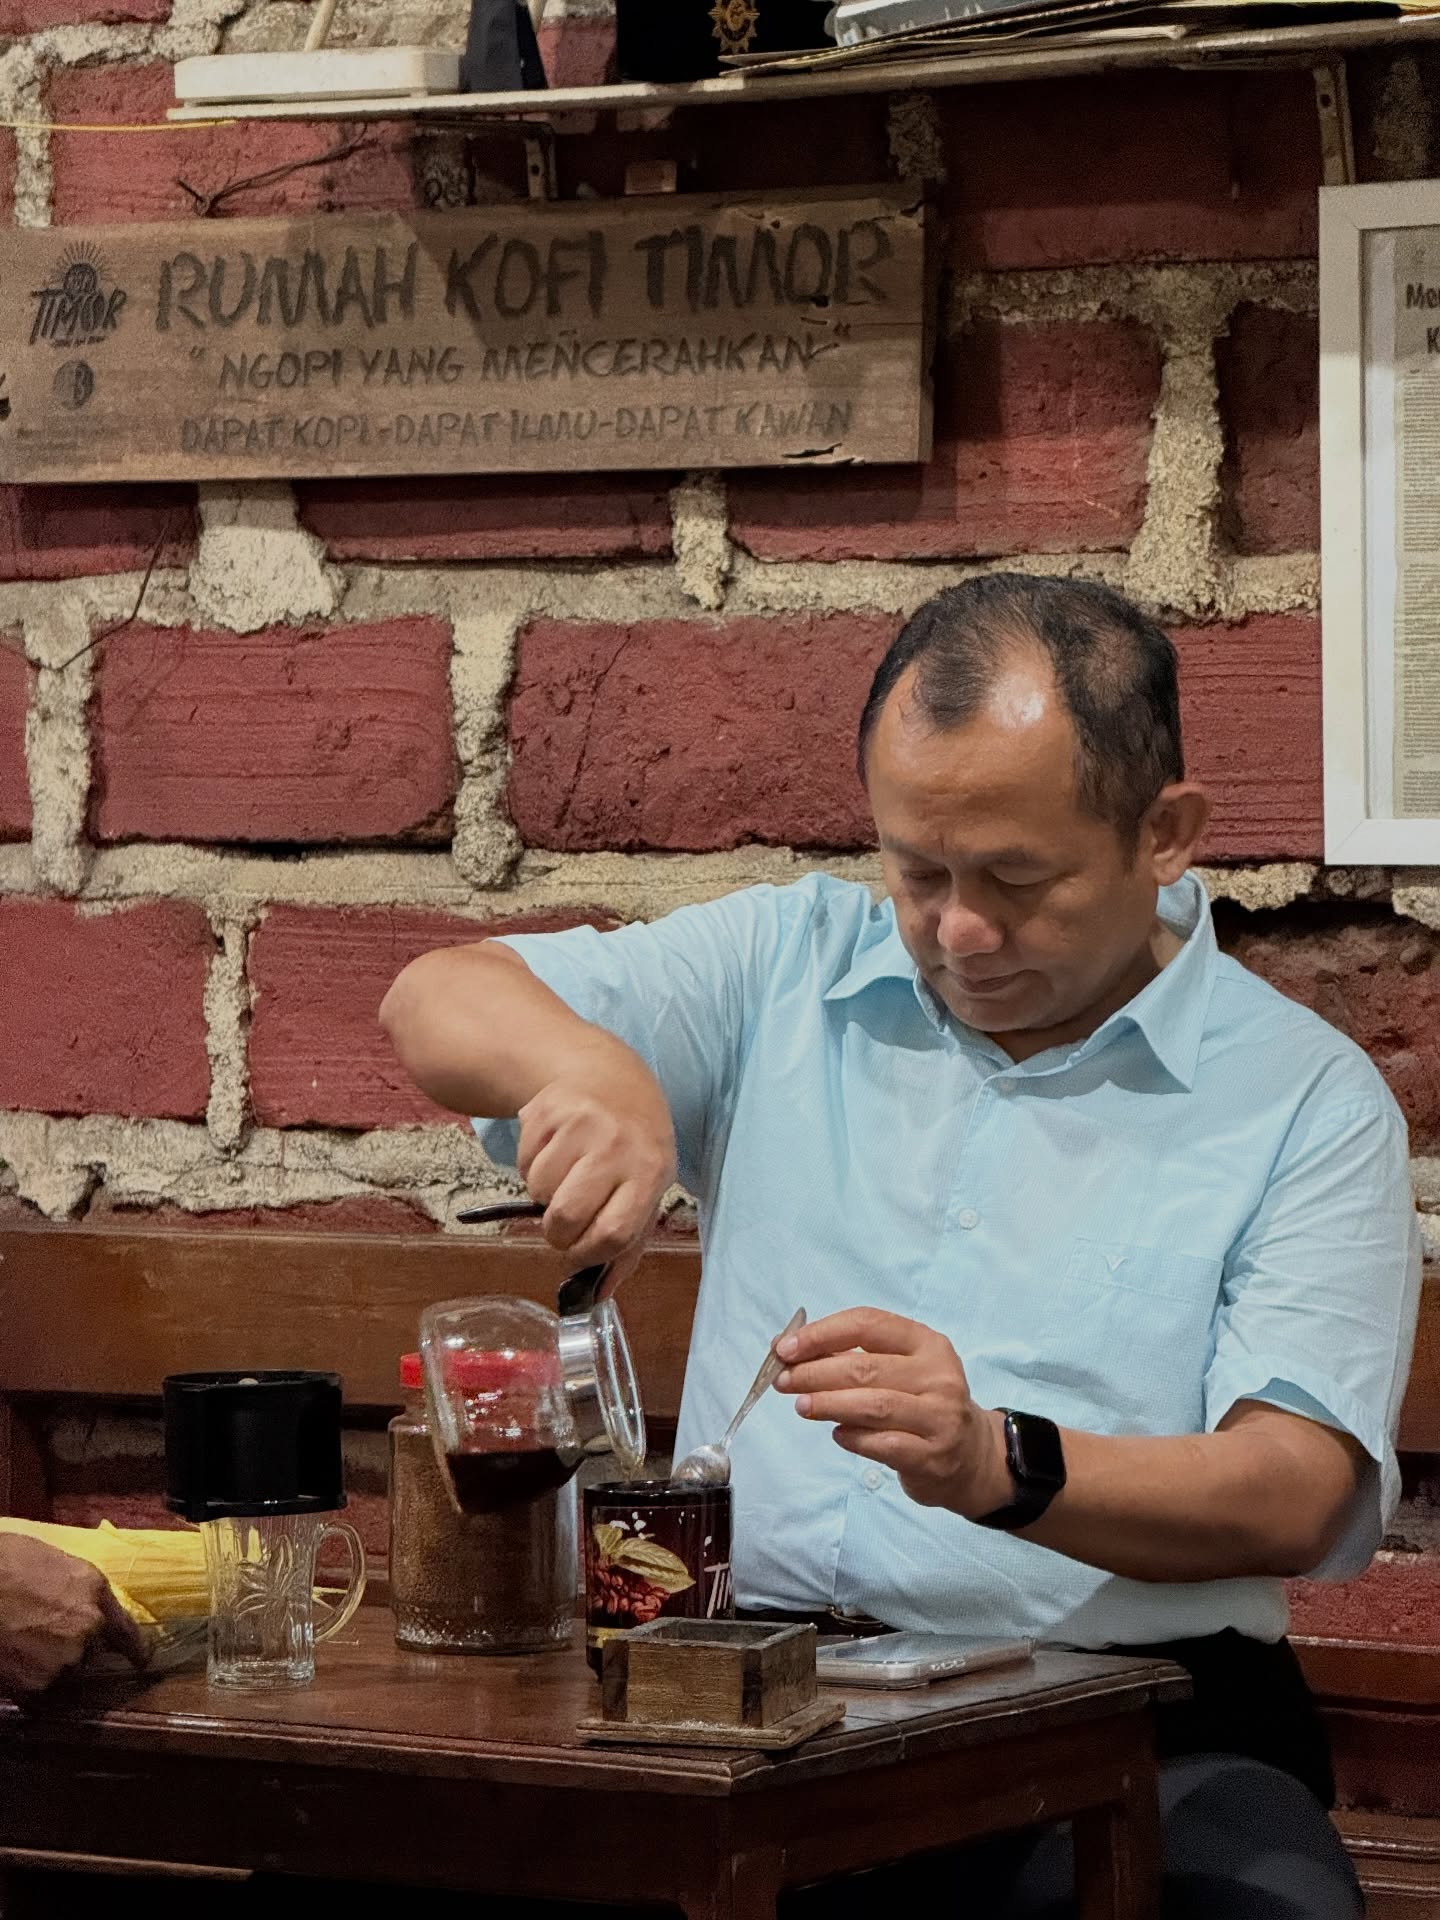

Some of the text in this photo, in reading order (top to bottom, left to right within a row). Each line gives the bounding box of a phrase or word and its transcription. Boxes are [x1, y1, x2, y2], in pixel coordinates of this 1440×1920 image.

[155, 219, 896, 332] RUMAH KOFI TIMOR
[1406, 283, 1440, 309] Me
[29, 286, 127, 346] TIMOR
[360, 346, 464, 386] YANG
[182, 414, 284, 453] DAPAT
[735, 400, 852, 439] KAWAN
